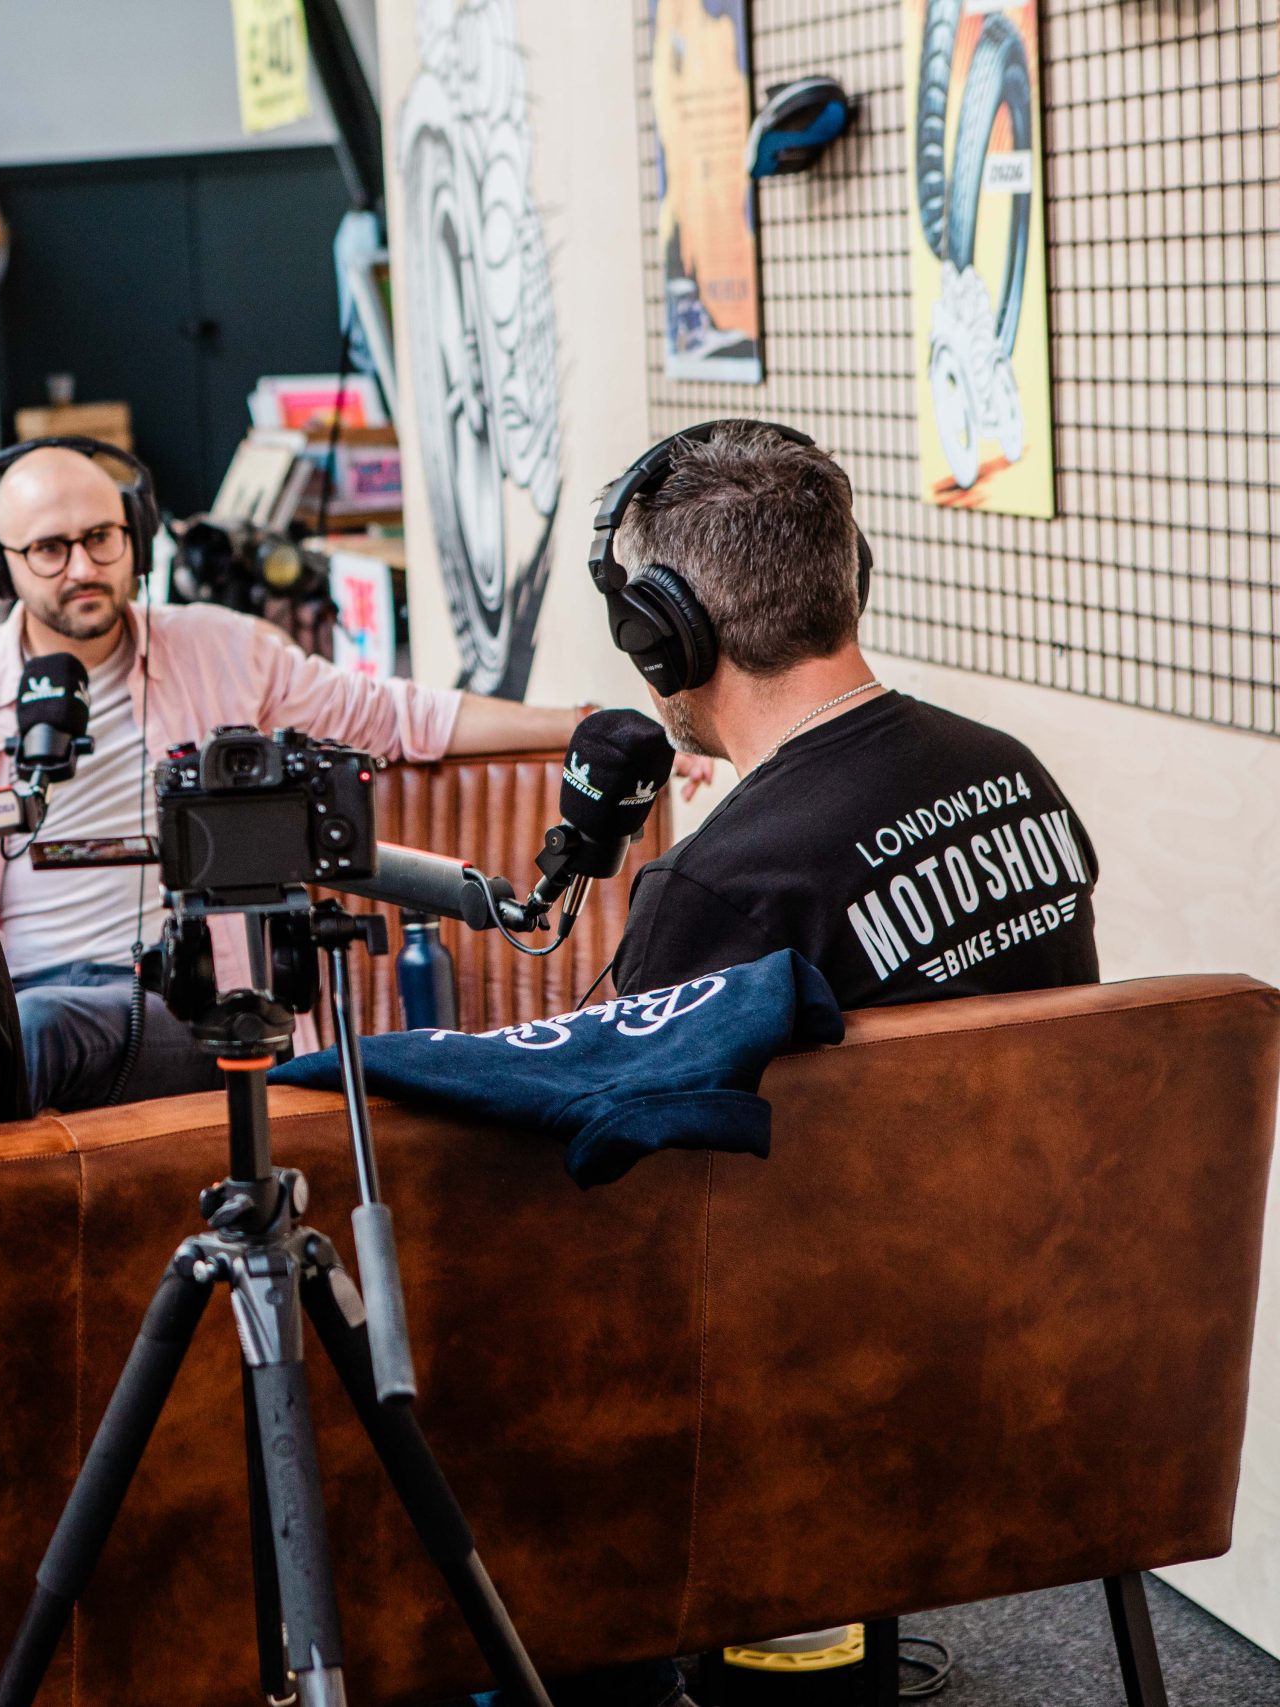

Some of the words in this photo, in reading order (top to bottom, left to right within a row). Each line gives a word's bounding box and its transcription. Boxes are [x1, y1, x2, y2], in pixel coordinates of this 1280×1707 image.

[855, 790, 972, 868] LONDON
[967, 771, 1032, 815] 2024
[943, 930, 995, 978] BIKE
[996, 903, 1061, 951] SHED
